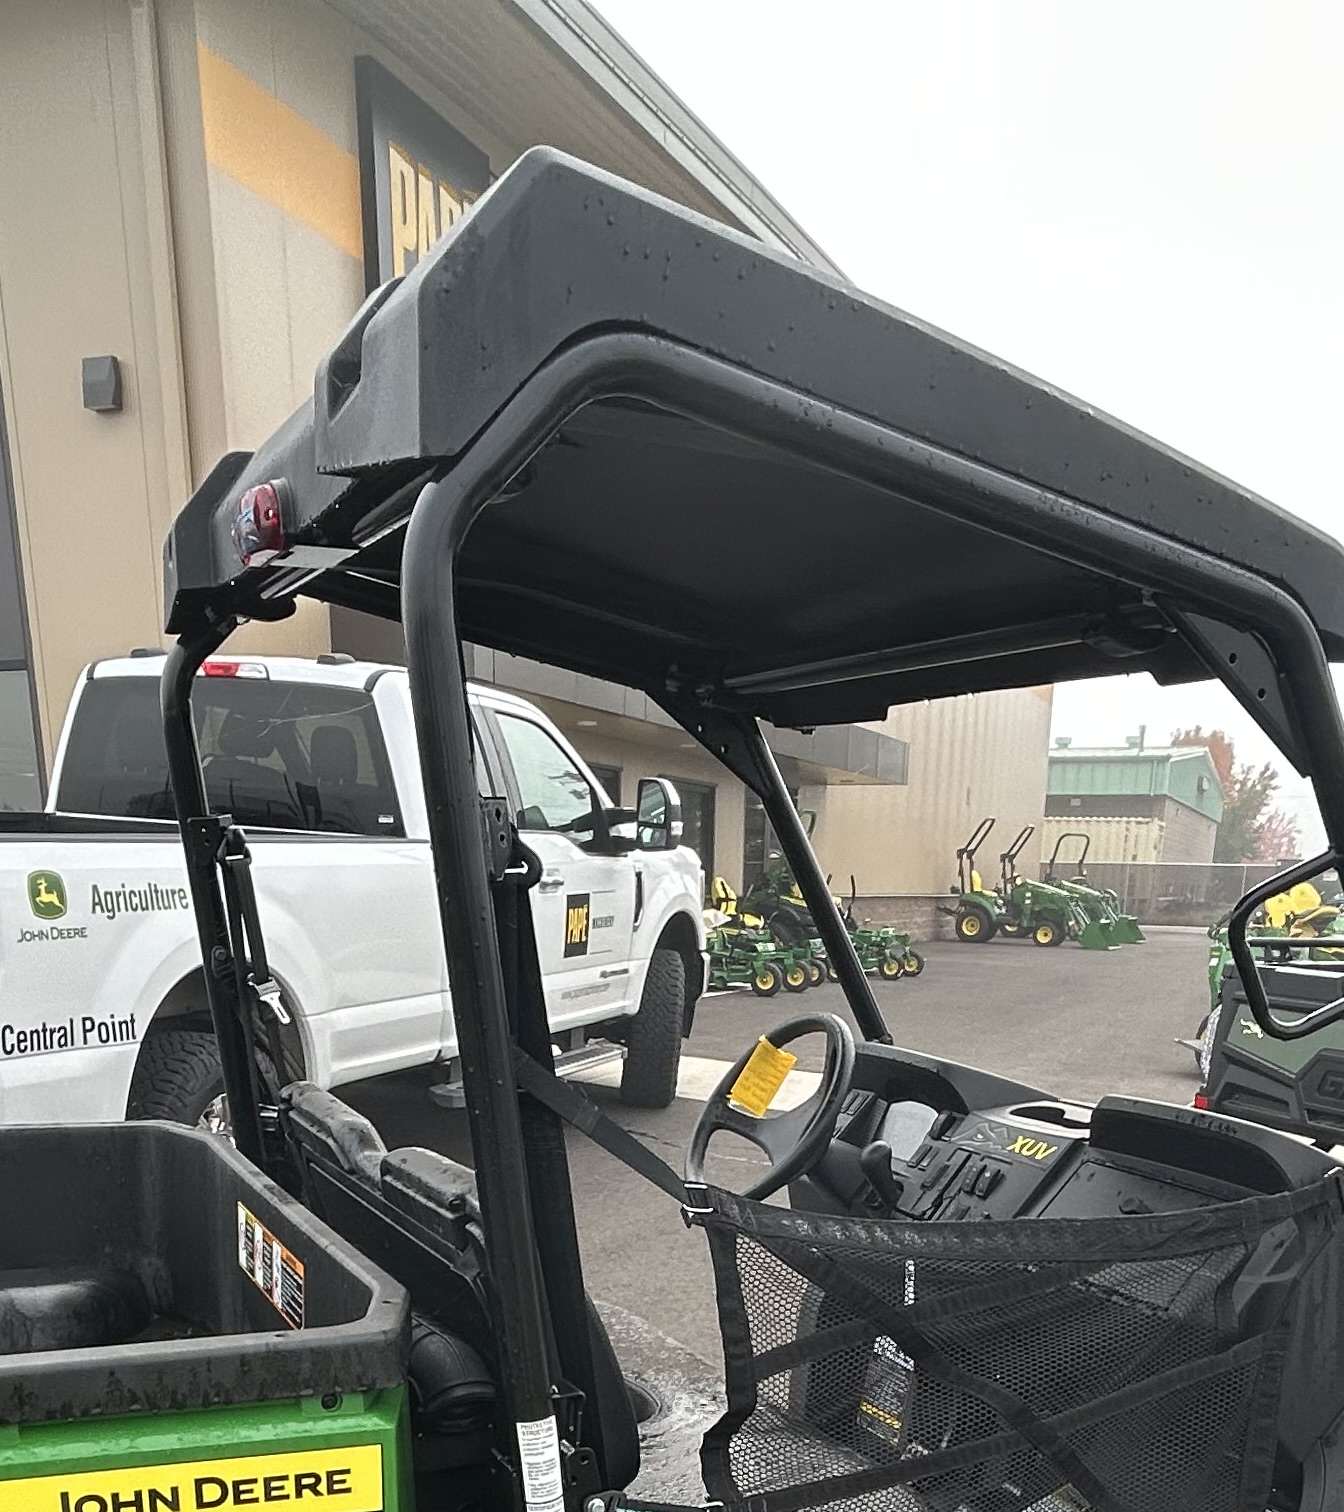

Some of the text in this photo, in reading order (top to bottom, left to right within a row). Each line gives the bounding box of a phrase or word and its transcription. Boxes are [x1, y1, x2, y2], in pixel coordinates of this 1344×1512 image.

[91, 882, 189, 921] Agriculture
[17, 926, 88, 944] JOHN DEERE
[1, 1013, 138, 1056] Central Point
[1006, 1135, 1058, 1160] XUV
[194, 1469, 353, 1509] DEERE
